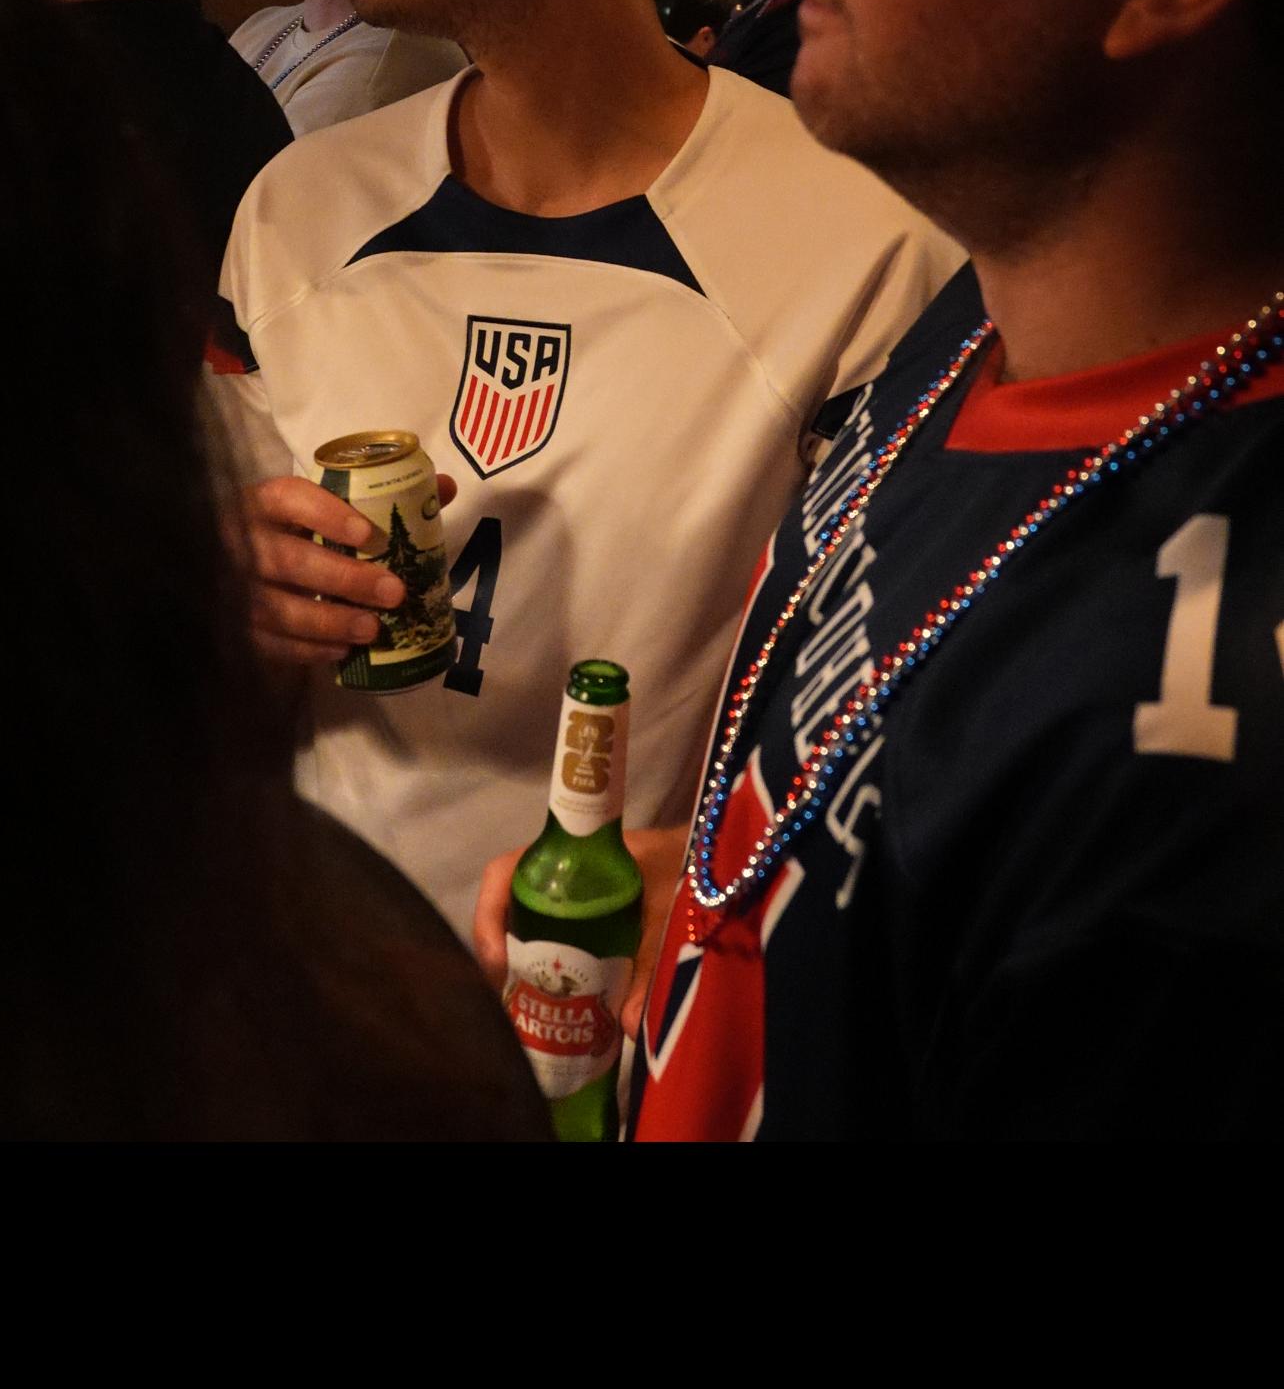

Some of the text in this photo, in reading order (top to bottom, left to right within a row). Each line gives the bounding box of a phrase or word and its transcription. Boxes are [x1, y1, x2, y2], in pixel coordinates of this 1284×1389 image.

[475, 329, 561, 390] USA
[443, 517, 502, 697] 4
[572, 775, 596, 789] FIFA
[518, 993, 595, 1024] STELLA
[515, 1013, 595, 1044] ARTOIS
